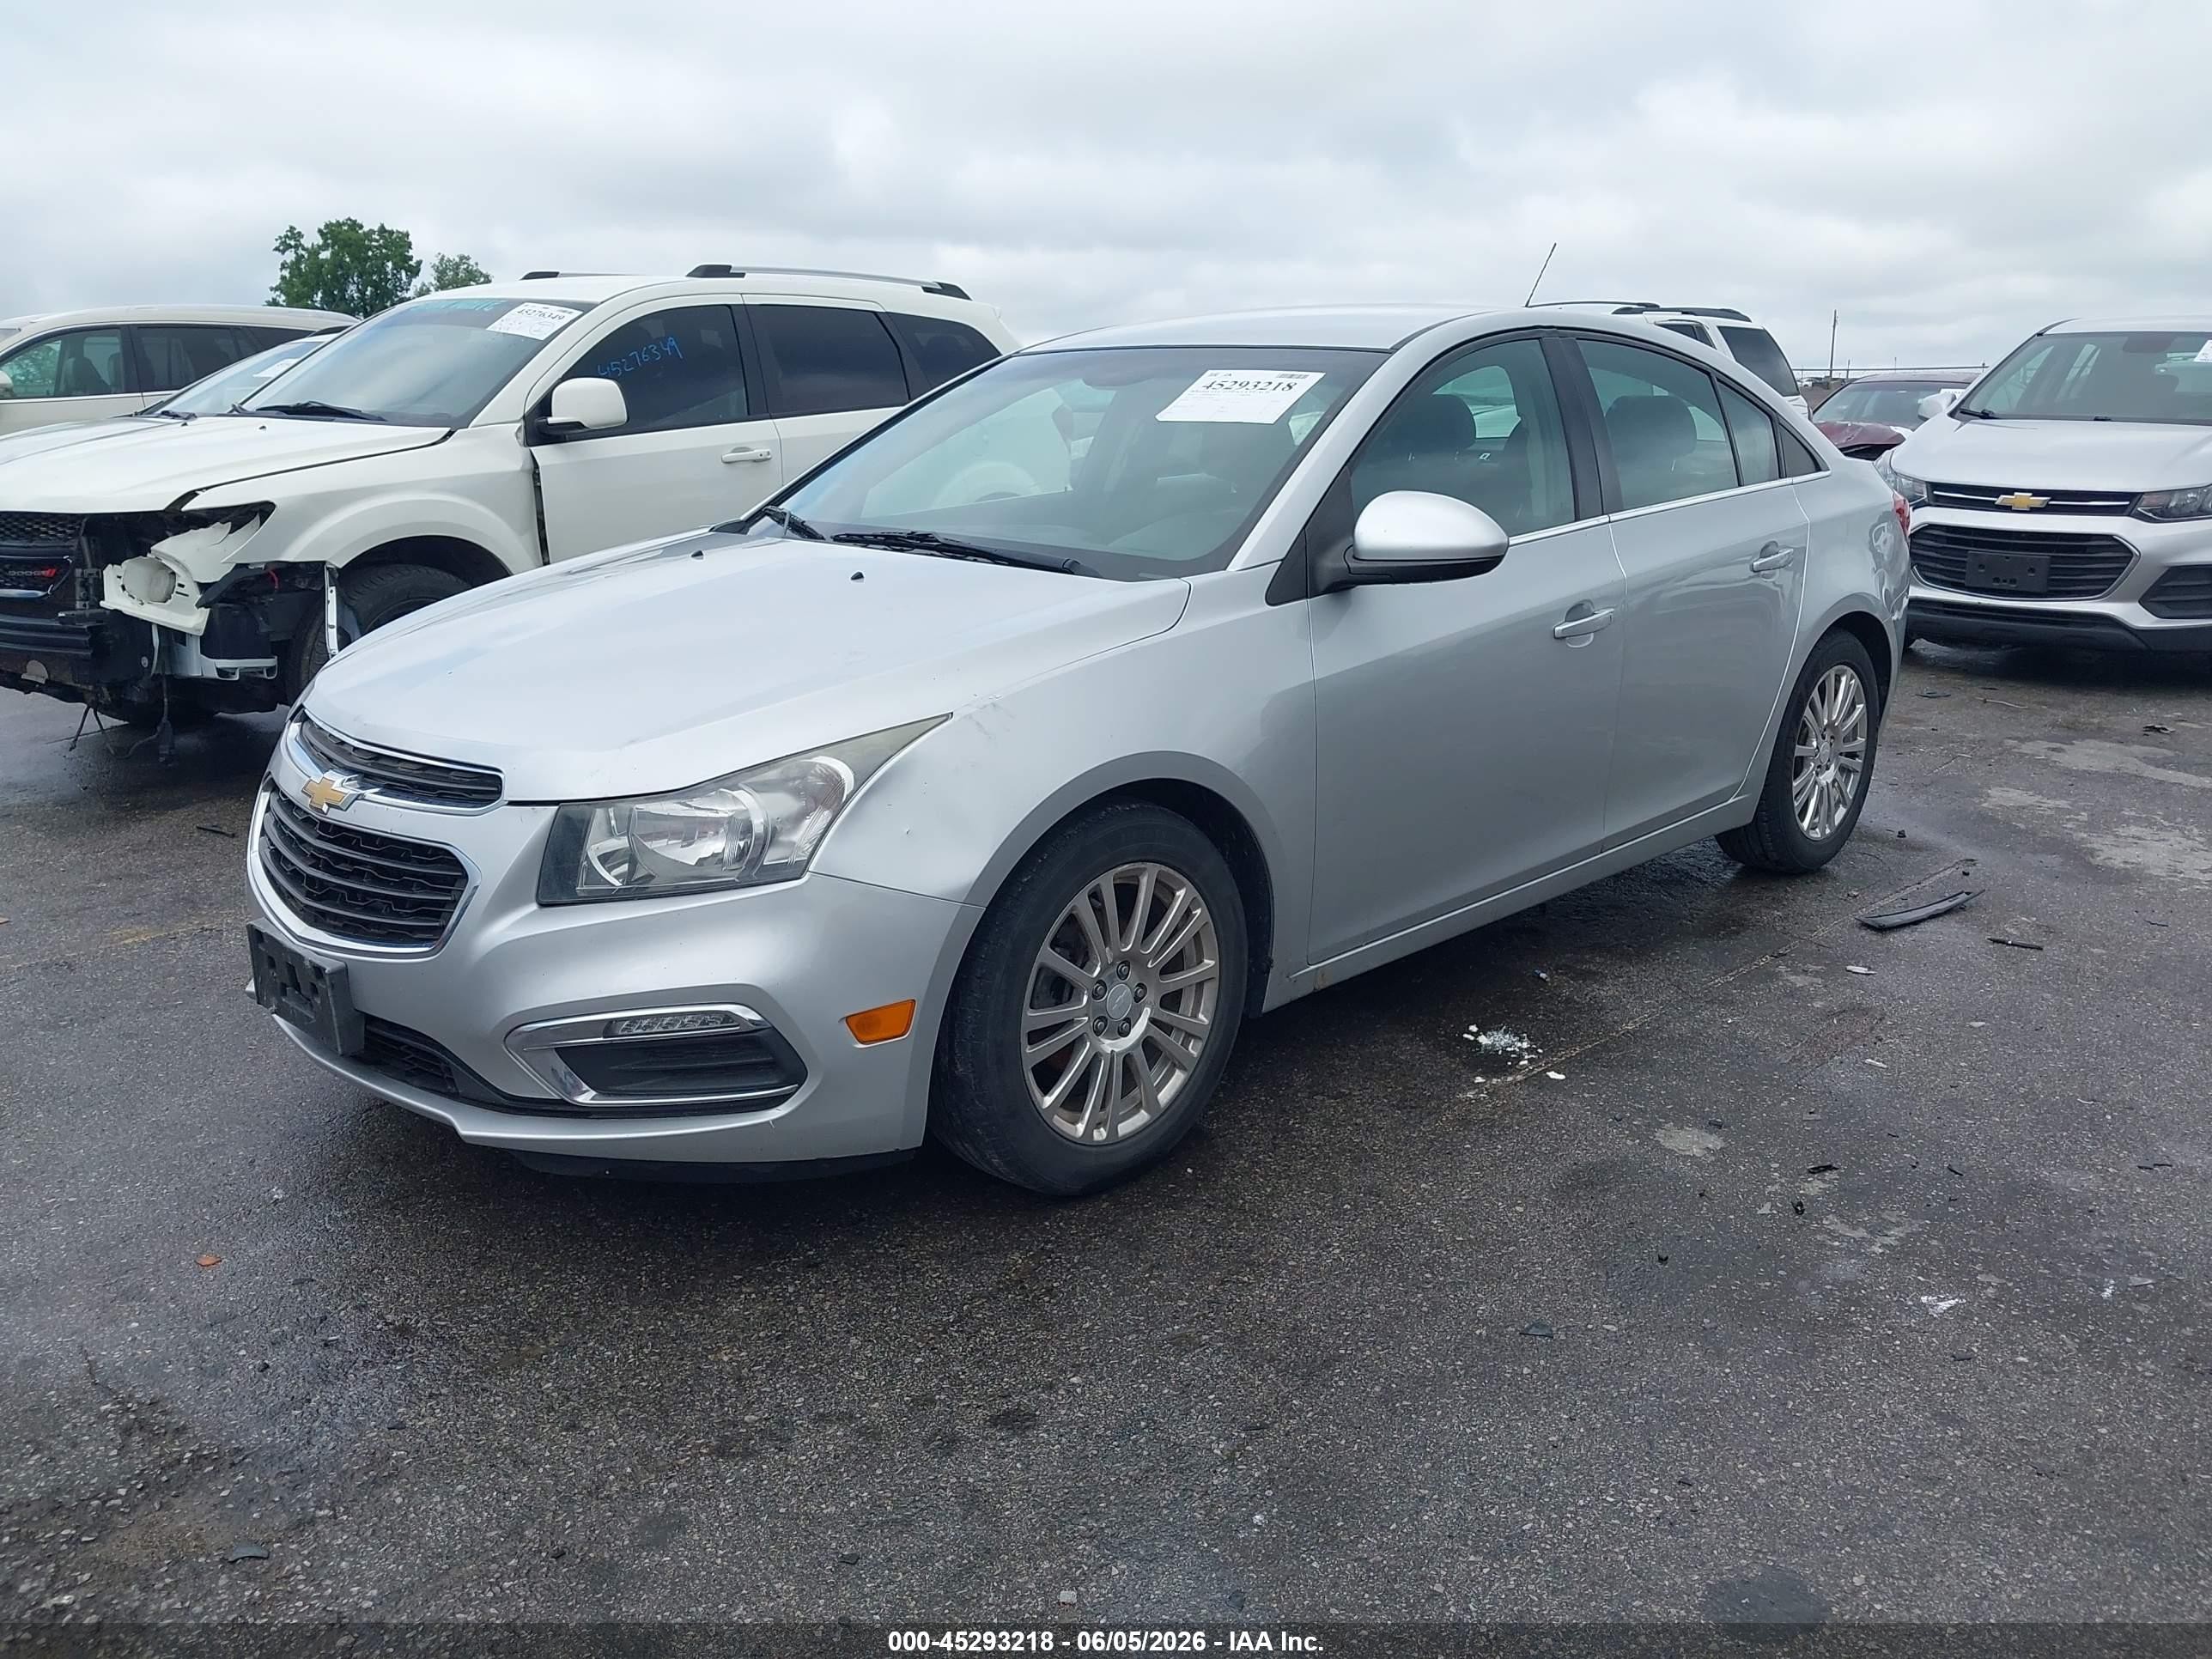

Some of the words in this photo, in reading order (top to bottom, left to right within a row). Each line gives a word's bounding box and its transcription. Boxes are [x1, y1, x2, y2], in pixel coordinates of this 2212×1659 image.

[517, 308, 565, 320] 45276349
[597, 336, 683, 377] 45276349
[1202, 380, 1297, 392] 45293218
